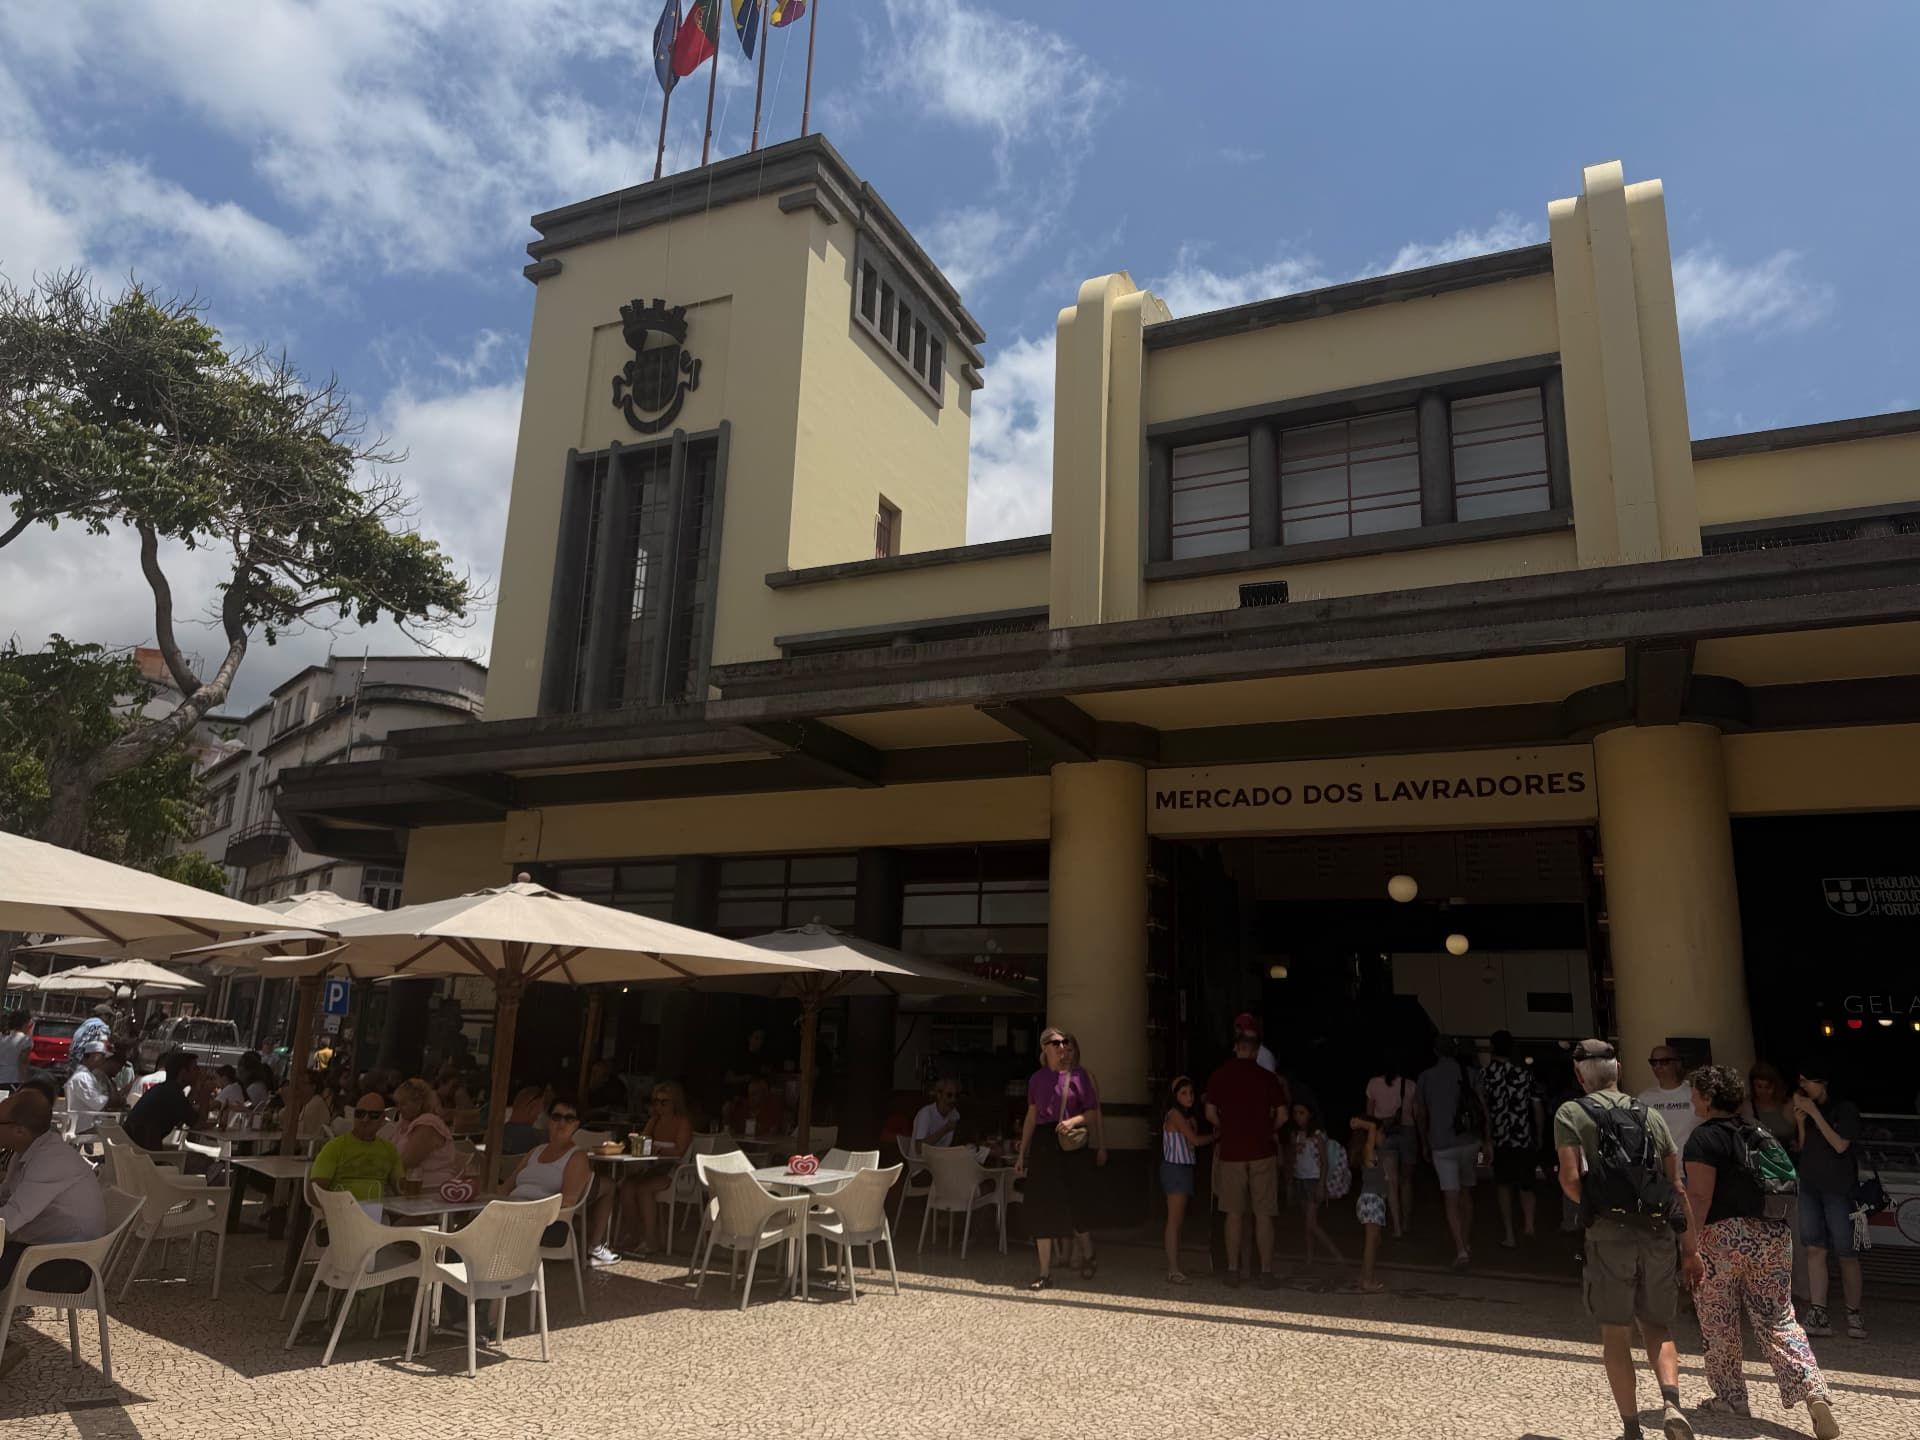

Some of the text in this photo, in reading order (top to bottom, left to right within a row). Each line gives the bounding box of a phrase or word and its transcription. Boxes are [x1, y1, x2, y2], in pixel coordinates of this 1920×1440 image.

[1155, 771, 1586, 810] MERCADO DOS LAVRADORES
[327, 983, 344, 1012] P
